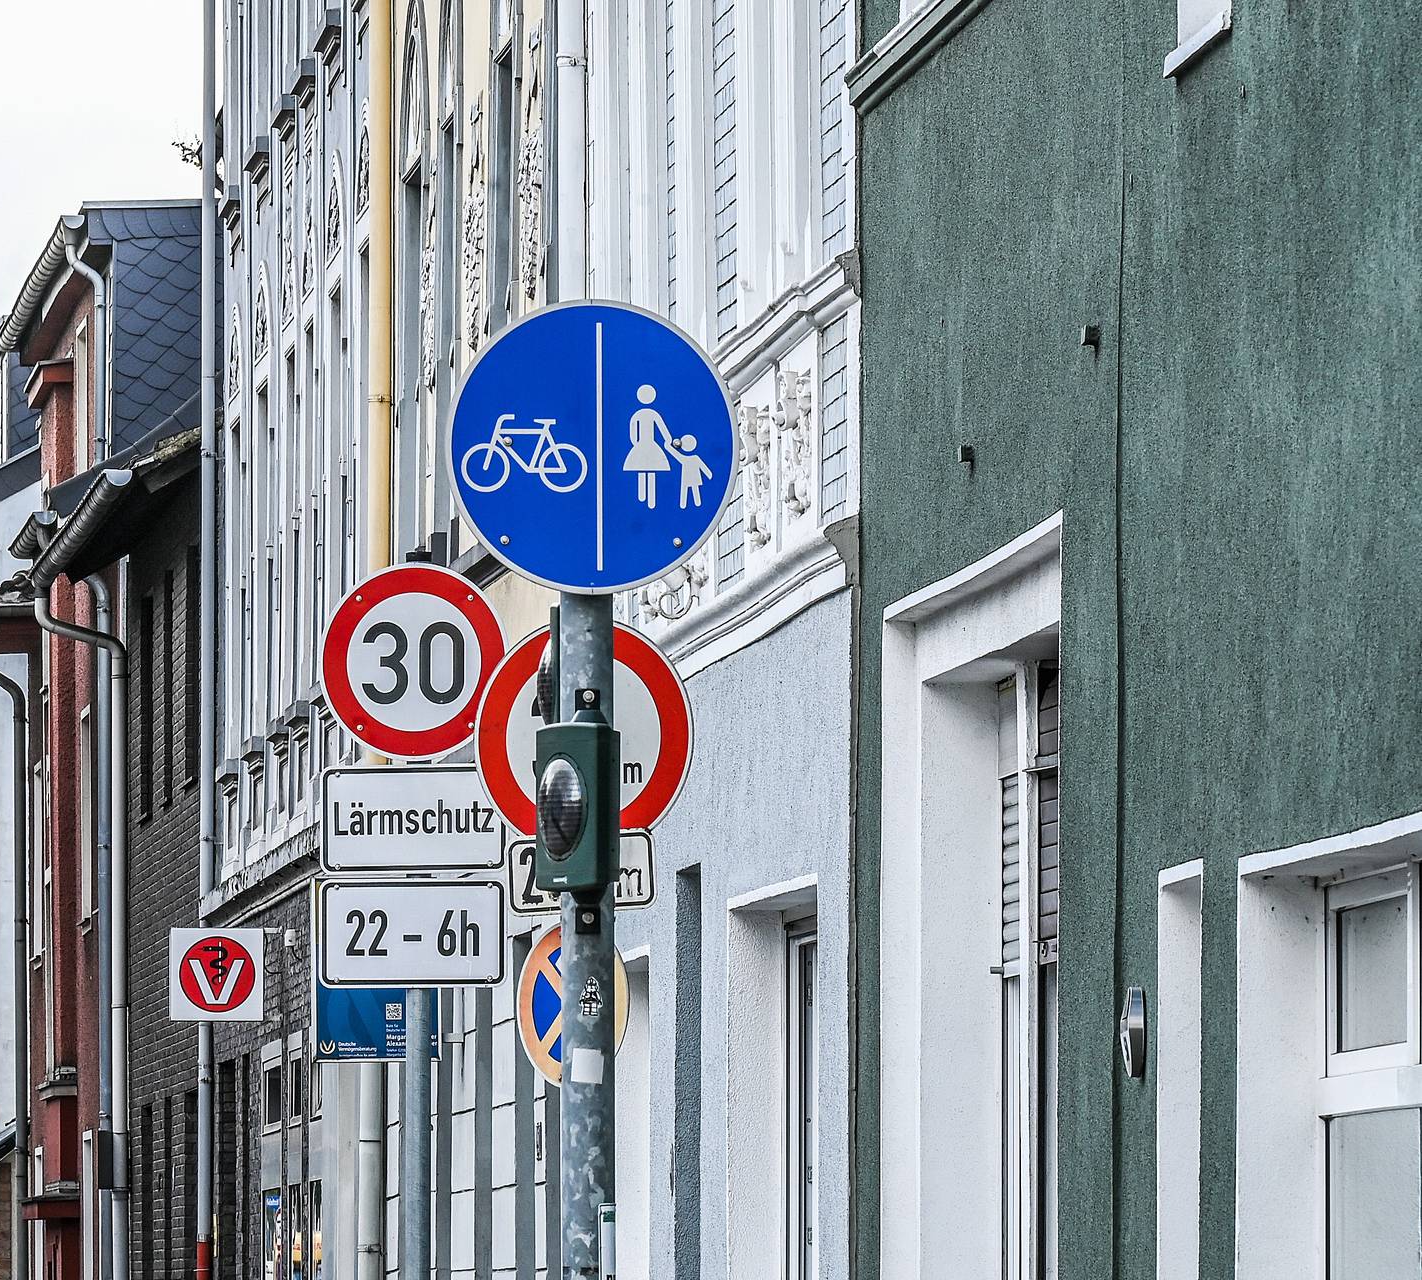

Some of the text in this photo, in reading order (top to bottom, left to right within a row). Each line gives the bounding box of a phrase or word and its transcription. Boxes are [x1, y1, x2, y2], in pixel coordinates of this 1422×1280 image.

[361, 621, 465, 704] 30
[334, 799, 495, 837] Lärmschutz
[346, 909, 388, 957] 22
[437, 909, 480, 957] 6h
